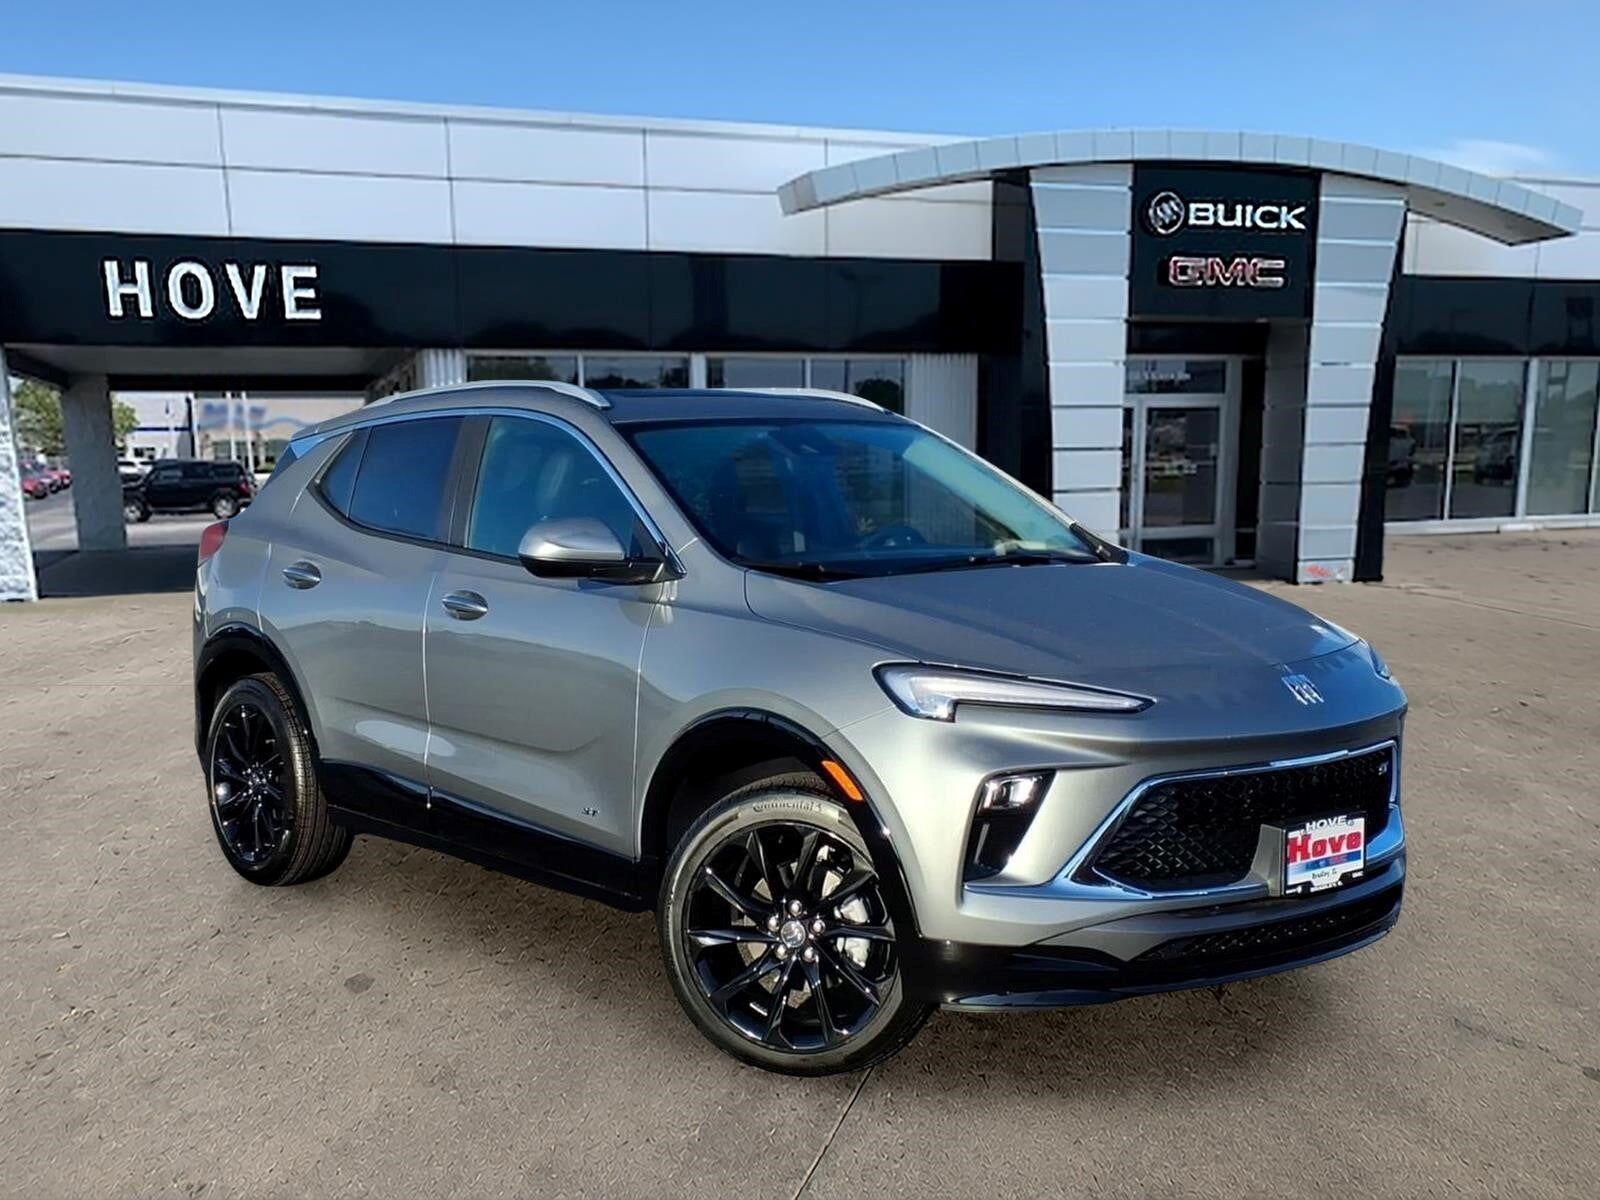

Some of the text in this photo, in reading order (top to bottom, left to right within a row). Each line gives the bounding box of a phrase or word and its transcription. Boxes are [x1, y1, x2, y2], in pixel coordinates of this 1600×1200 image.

[1187, 202, 1307, 230] BUICK
[1168, 255, 1285, 288] GMC
[103, 260, 322, 320] HOVE
[1304, 815, 1348, 832] HOVE
[1286, 831, 1362, 864] Hove
